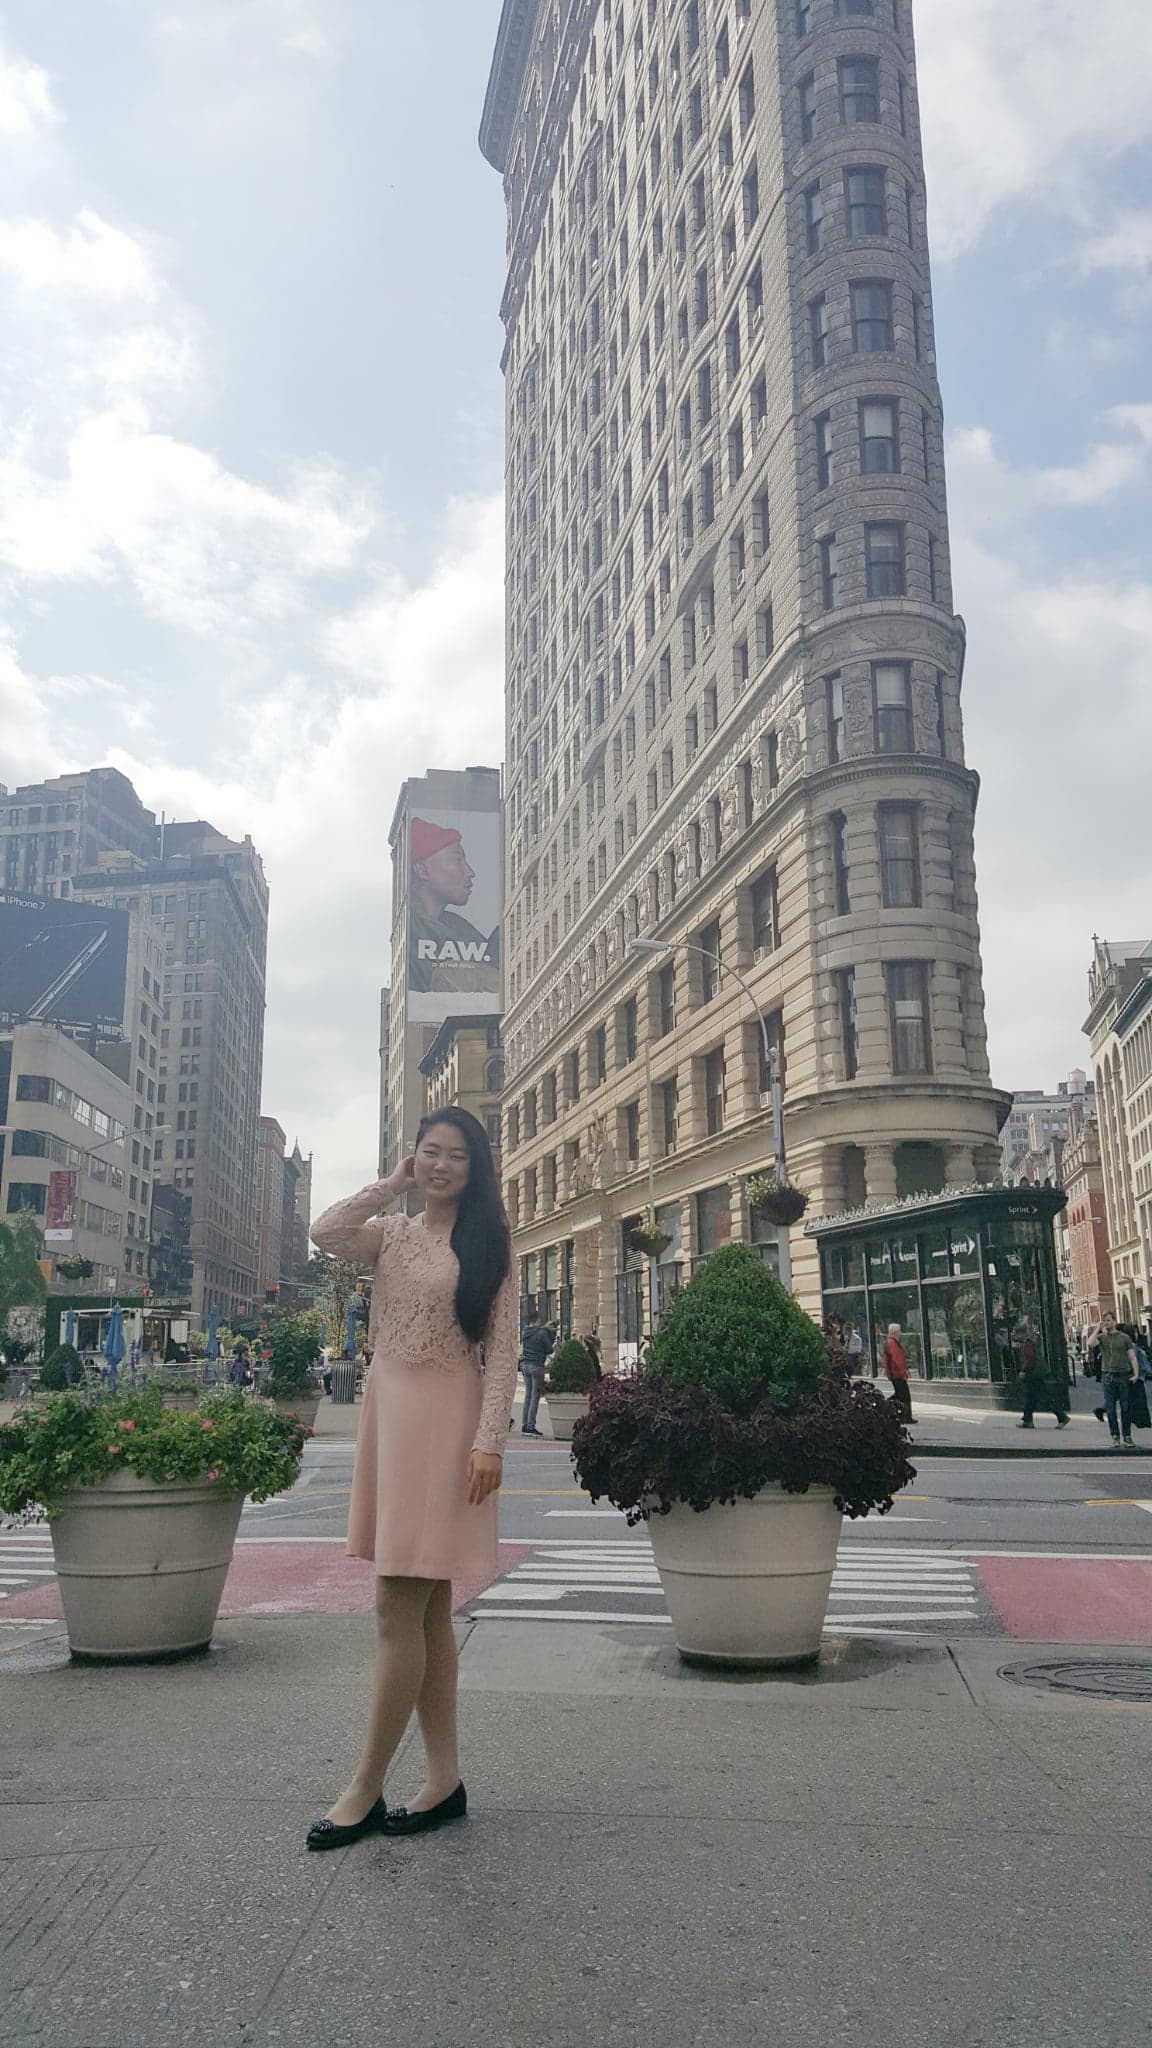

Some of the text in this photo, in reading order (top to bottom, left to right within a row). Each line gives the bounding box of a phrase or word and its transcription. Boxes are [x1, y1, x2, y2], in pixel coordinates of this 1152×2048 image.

[7, 896, 46, 910] iPhone 7
[418, 939, 491, 961] RAW.
[1008, 1206, 1030, 1214] Sprint
[951, 1242, 967, 1256] Sprint
